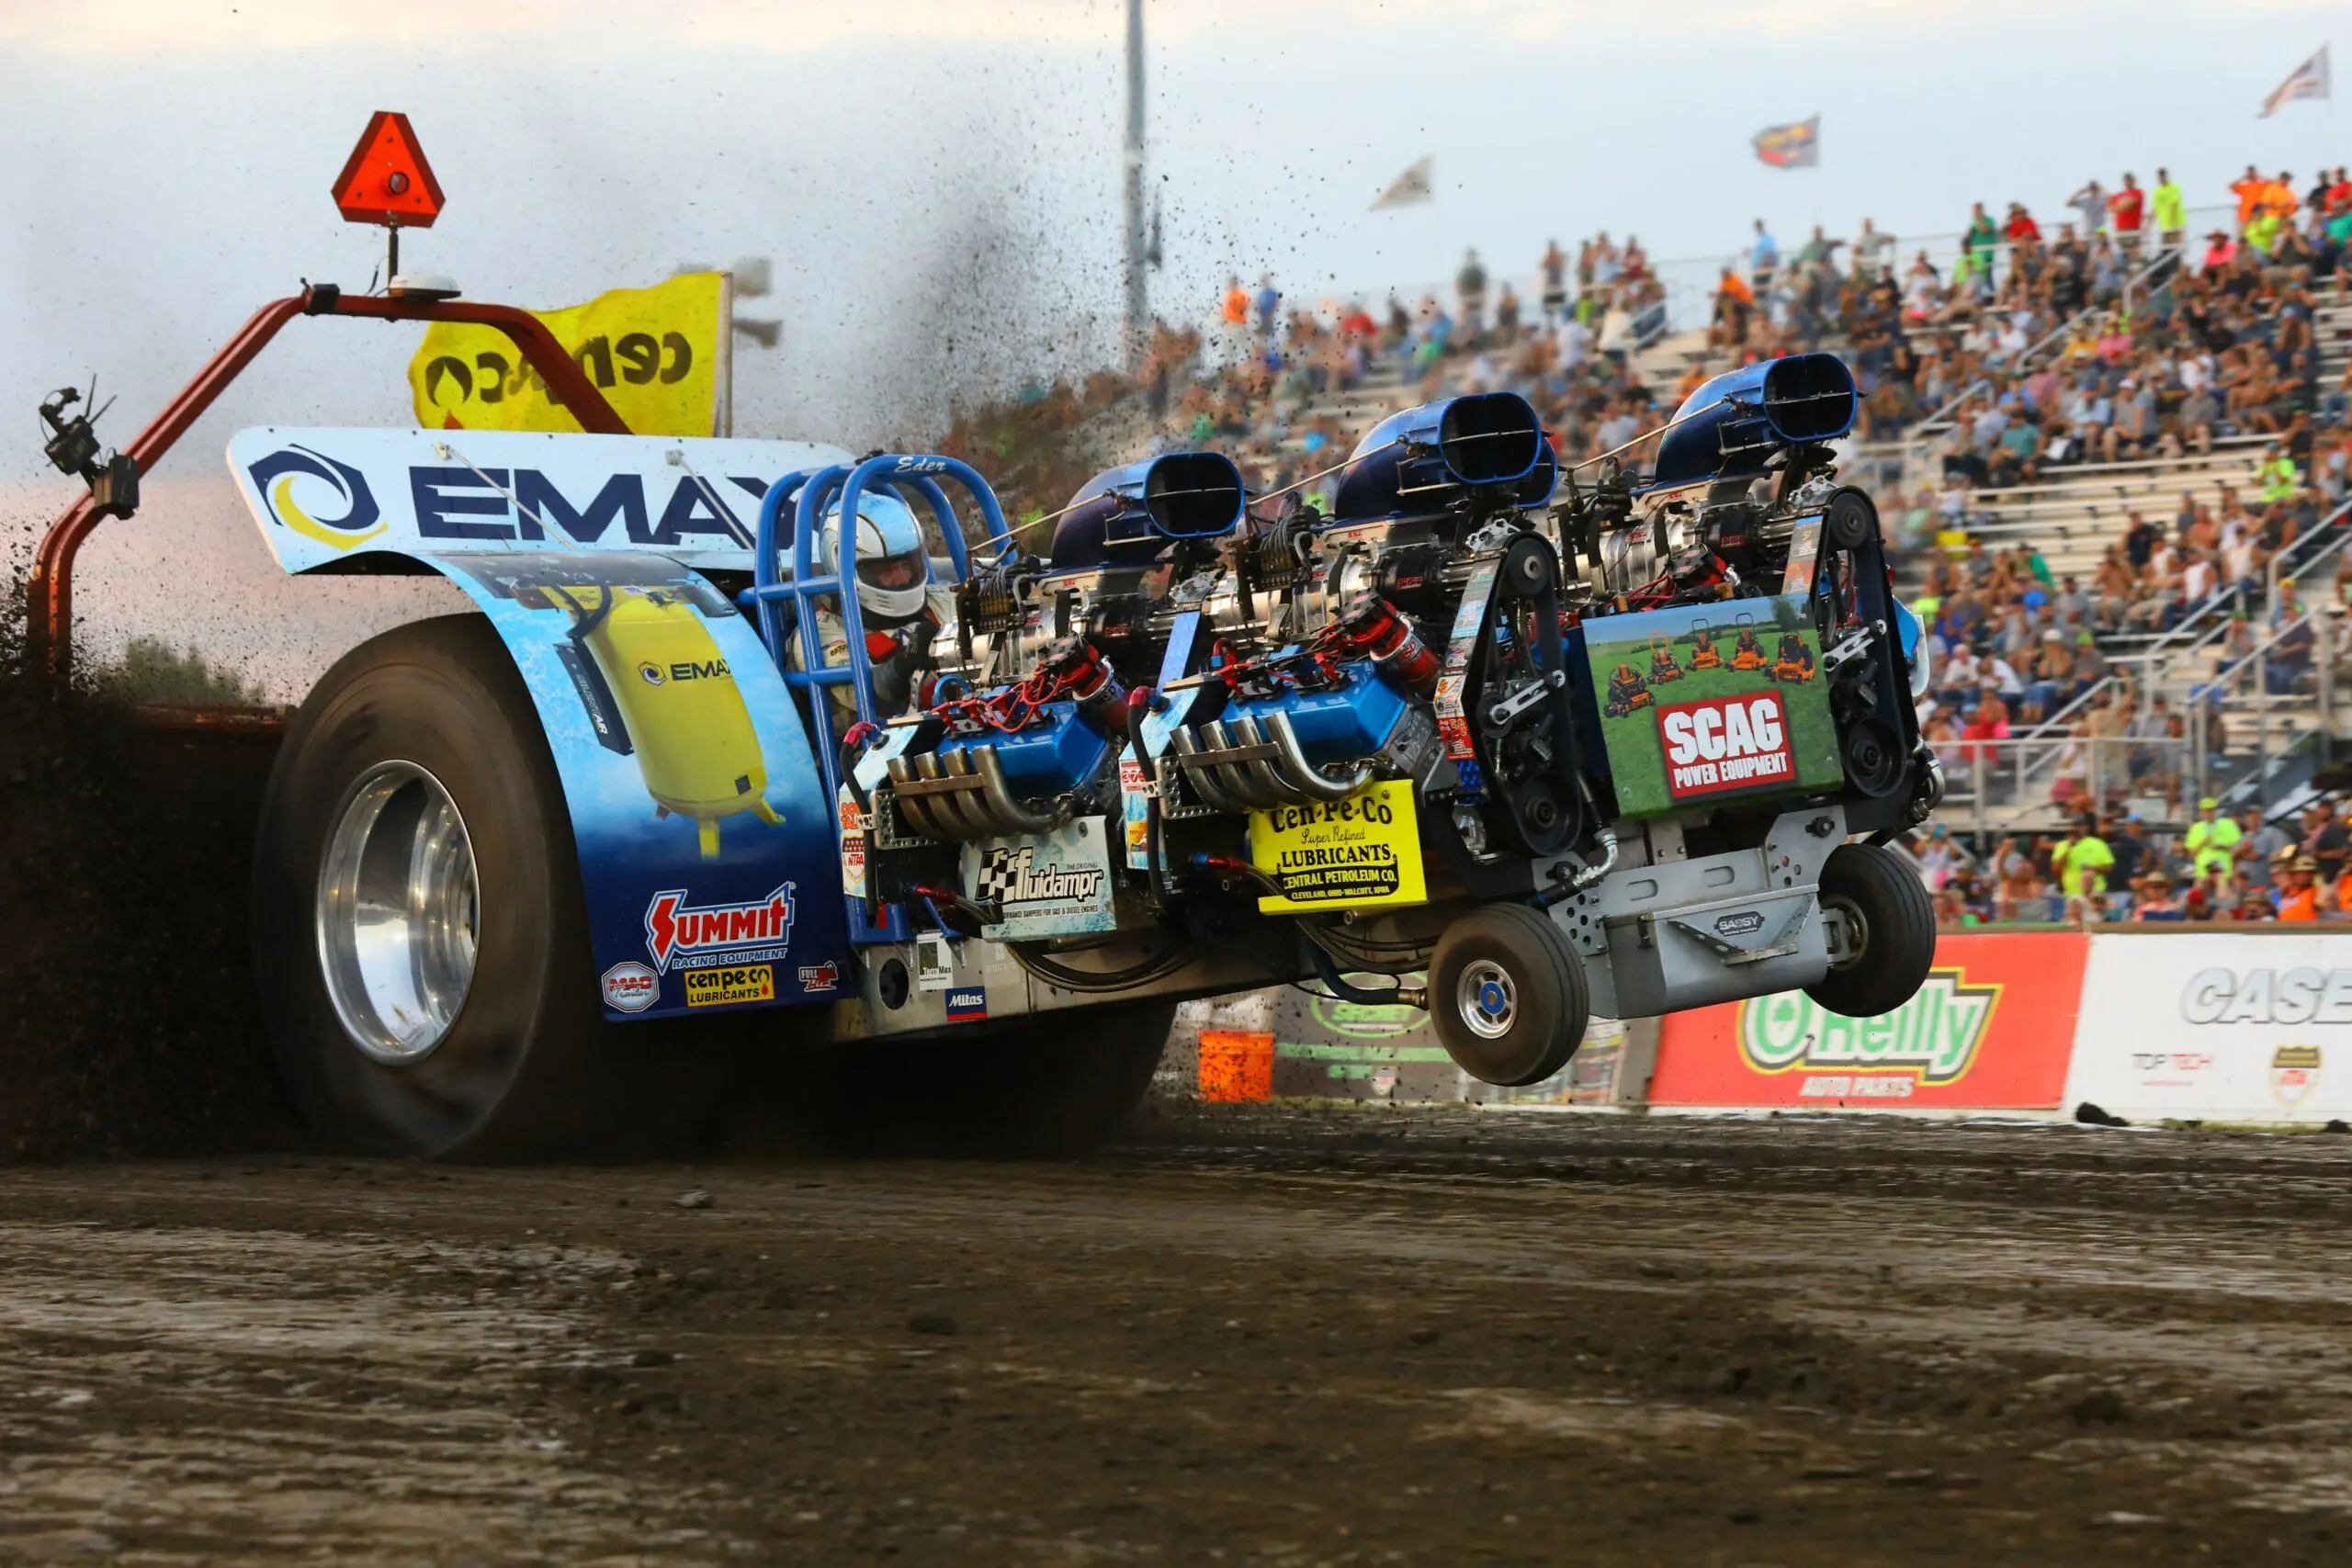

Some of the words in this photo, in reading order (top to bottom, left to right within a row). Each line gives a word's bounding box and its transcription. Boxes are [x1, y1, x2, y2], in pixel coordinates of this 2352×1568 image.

[894, 456, 946, 473] Eder
[1663, 698, 1783, 765] SCAG
[1673, 762, 1718, 789] POWER
[1719, 751, 1788, 782] EQUIPMENT
[1301, 827, 1330, 847] Super
[1332, 826, 1366, 845] Refined
[1281, 843, 1392, 868] LUBRICANTS
[1015, 847, 1104, 904] fluidampr
[1283, 873, 1323, 890] CENTRAL
[1325, 869, 1380, 885] PETROLEUM
[672, 954, 718, 970] RACING
[718, 948, 788, 964] EQUIPMENT
[690, 987, 760, 1004] LUBRICANTS
[949, 993, 983, 1008] Mitas
[2181, 966, 2352, 1024] CASE
